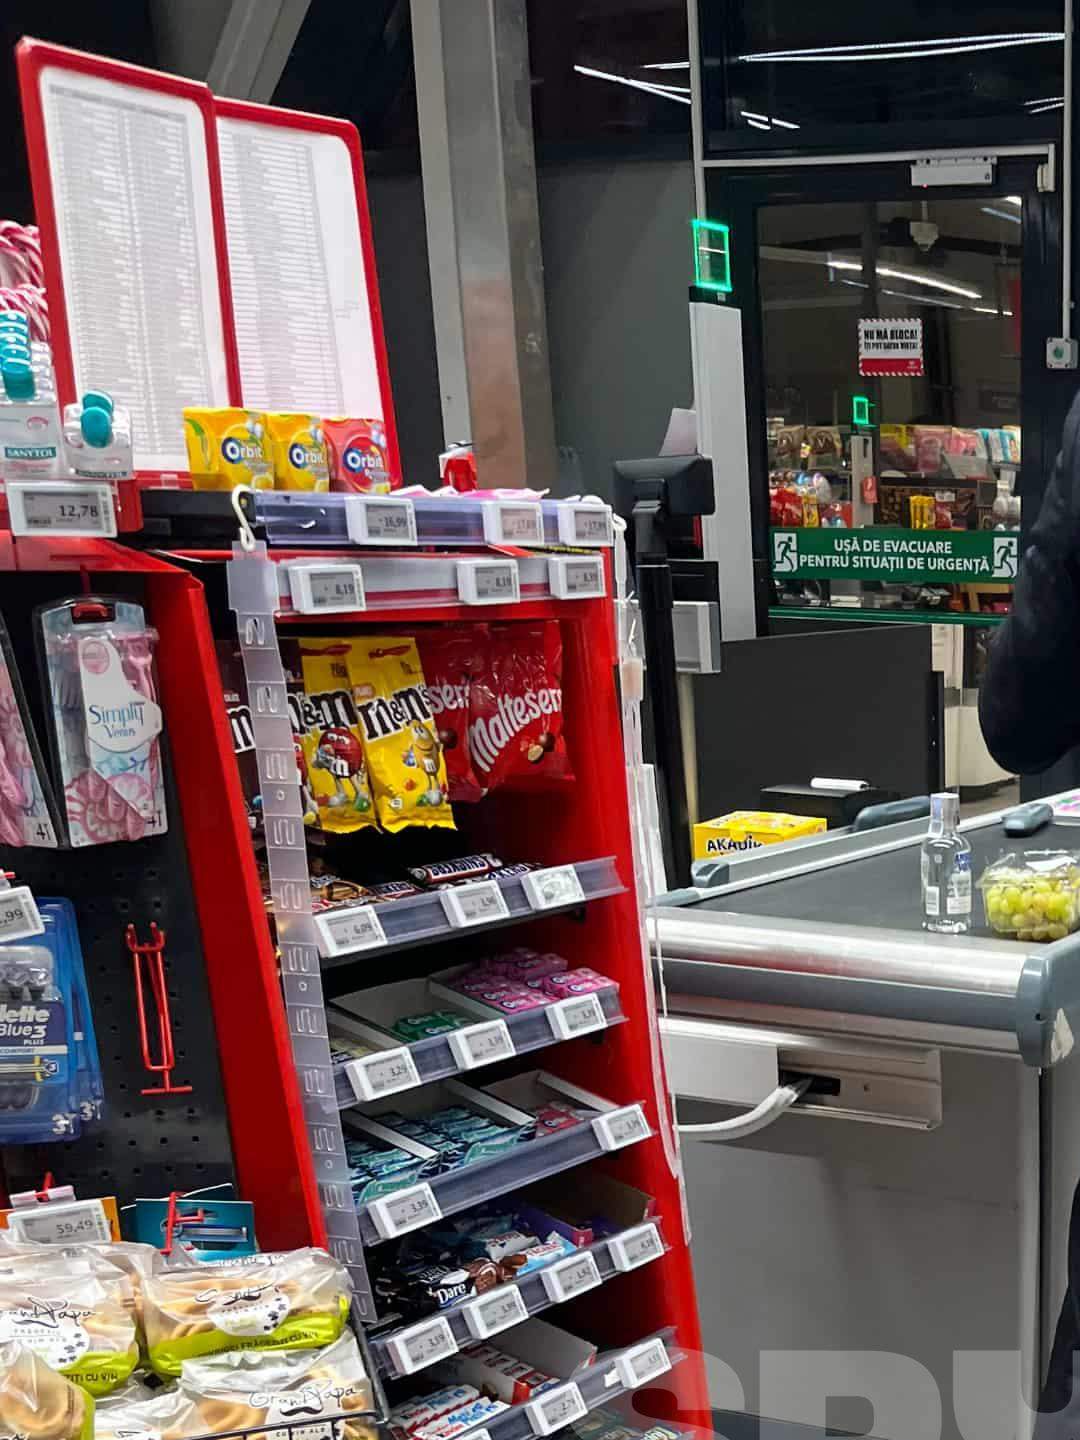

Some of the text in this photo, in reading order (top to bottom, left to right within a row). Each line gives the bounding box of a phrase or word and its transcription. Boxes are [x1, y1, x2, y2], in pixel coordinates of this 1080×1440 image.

[221, 437, 263, 464] Orbit
[289, 443, 324, 469] Orbit
[342, 447, 384, 473] Orbit
[59, 505, 99, 518] 12,78
[834, 537, 953, 556] UȘĂ DE EVACUARE
[799, 555, 990, 575] PENTRU SITUAȚII DE URGENȚĂ
[88, 701, 148, 726] Simply
[103, 724, 136, 738] Venus
[56, 1219, 93, 1235] 59,49
[437, 1282, 468, 1305] Dare
